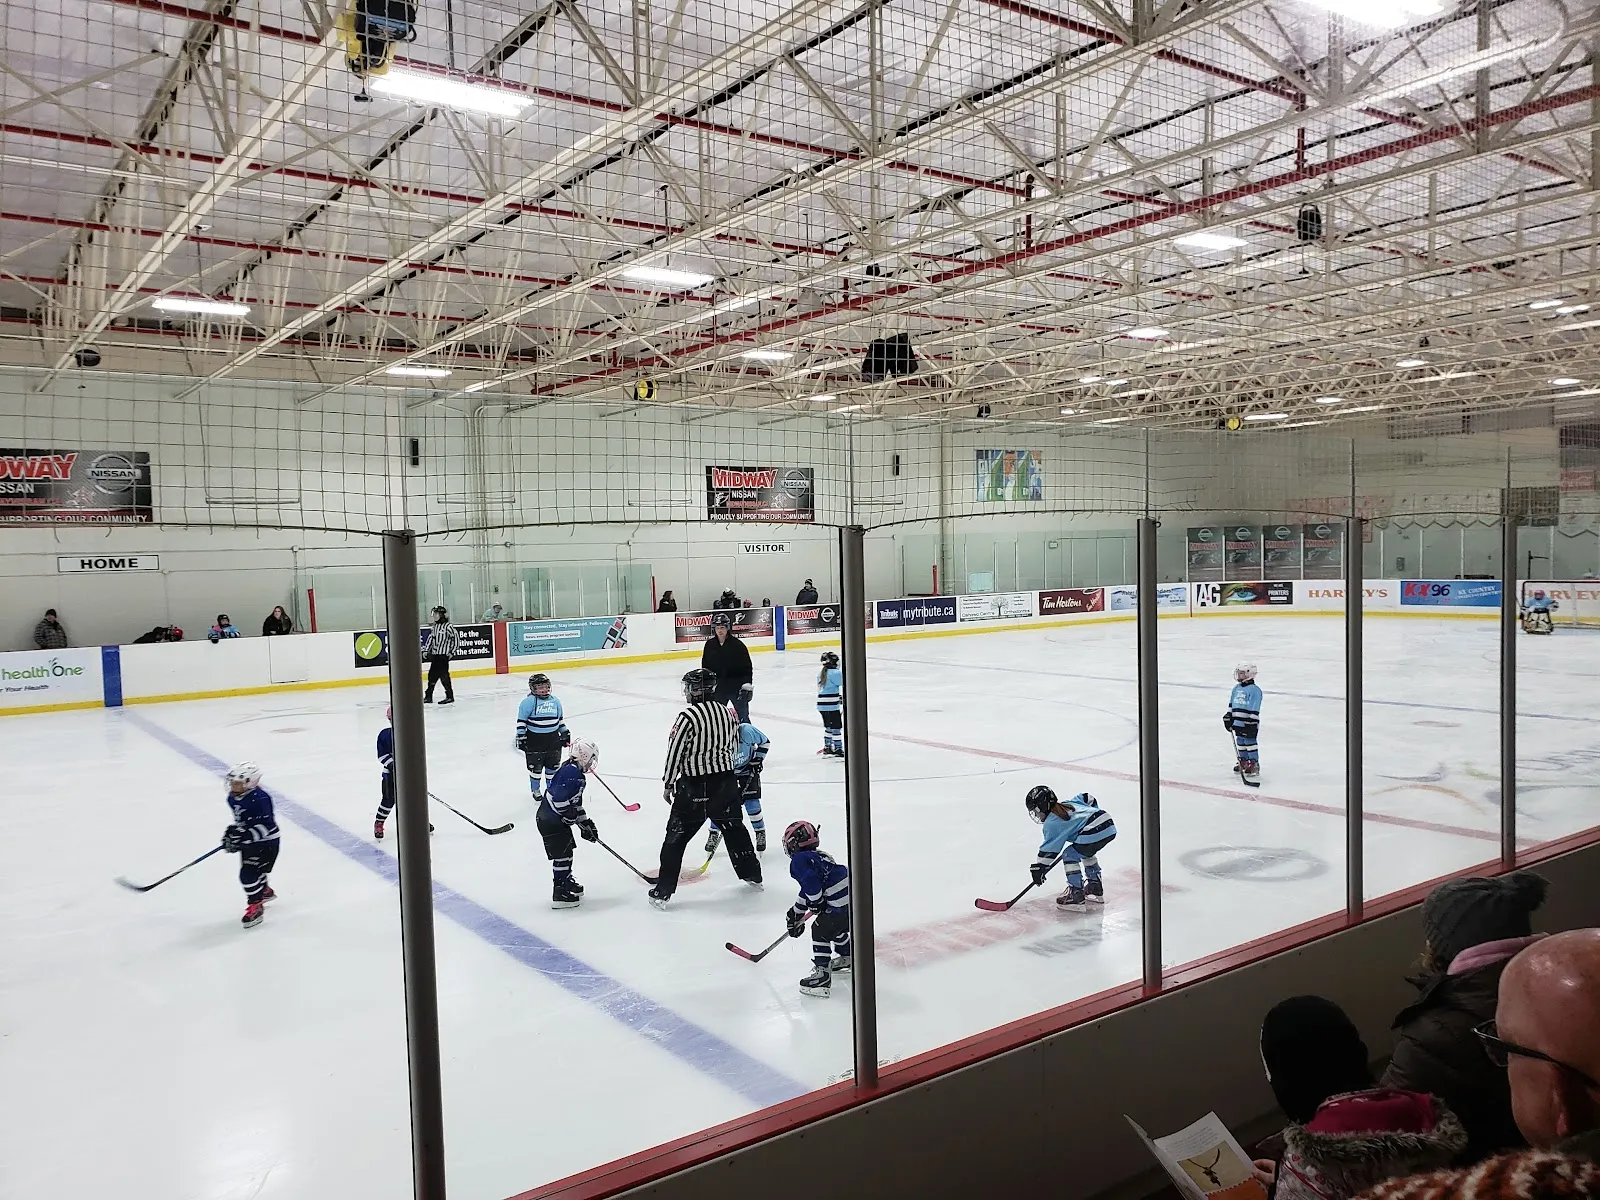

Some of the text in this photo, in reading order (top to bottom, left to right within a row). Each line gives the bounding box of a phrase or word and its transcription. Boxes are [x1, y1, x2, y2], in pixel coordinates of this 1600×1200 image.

[91, 470, 136, 478] NISSAN
[712, 467, 778, 488] MIDWAY
[731, 490, 757, 499] NISSAN
[89, 514, 148, 522] COMMUNITY
[744, 544, 785, 553] VISITOR
[80, 558, 139, 569] HOME
[1308, 589, 1388, 598] HARY'S
[1042, 596, 1082, 609] Tim Hortons
[787, 608, 820, 620] MIDWAY
[903, 605, 954, 621] mytribute.ca
[676, 613, 713, 627] MIDWAY
[459, 630, 480, 638] Be the
[459, 638, 490, 647] itive voice
[457, 648, 468, 656] the
[468, 647, 490, 655] stands.
